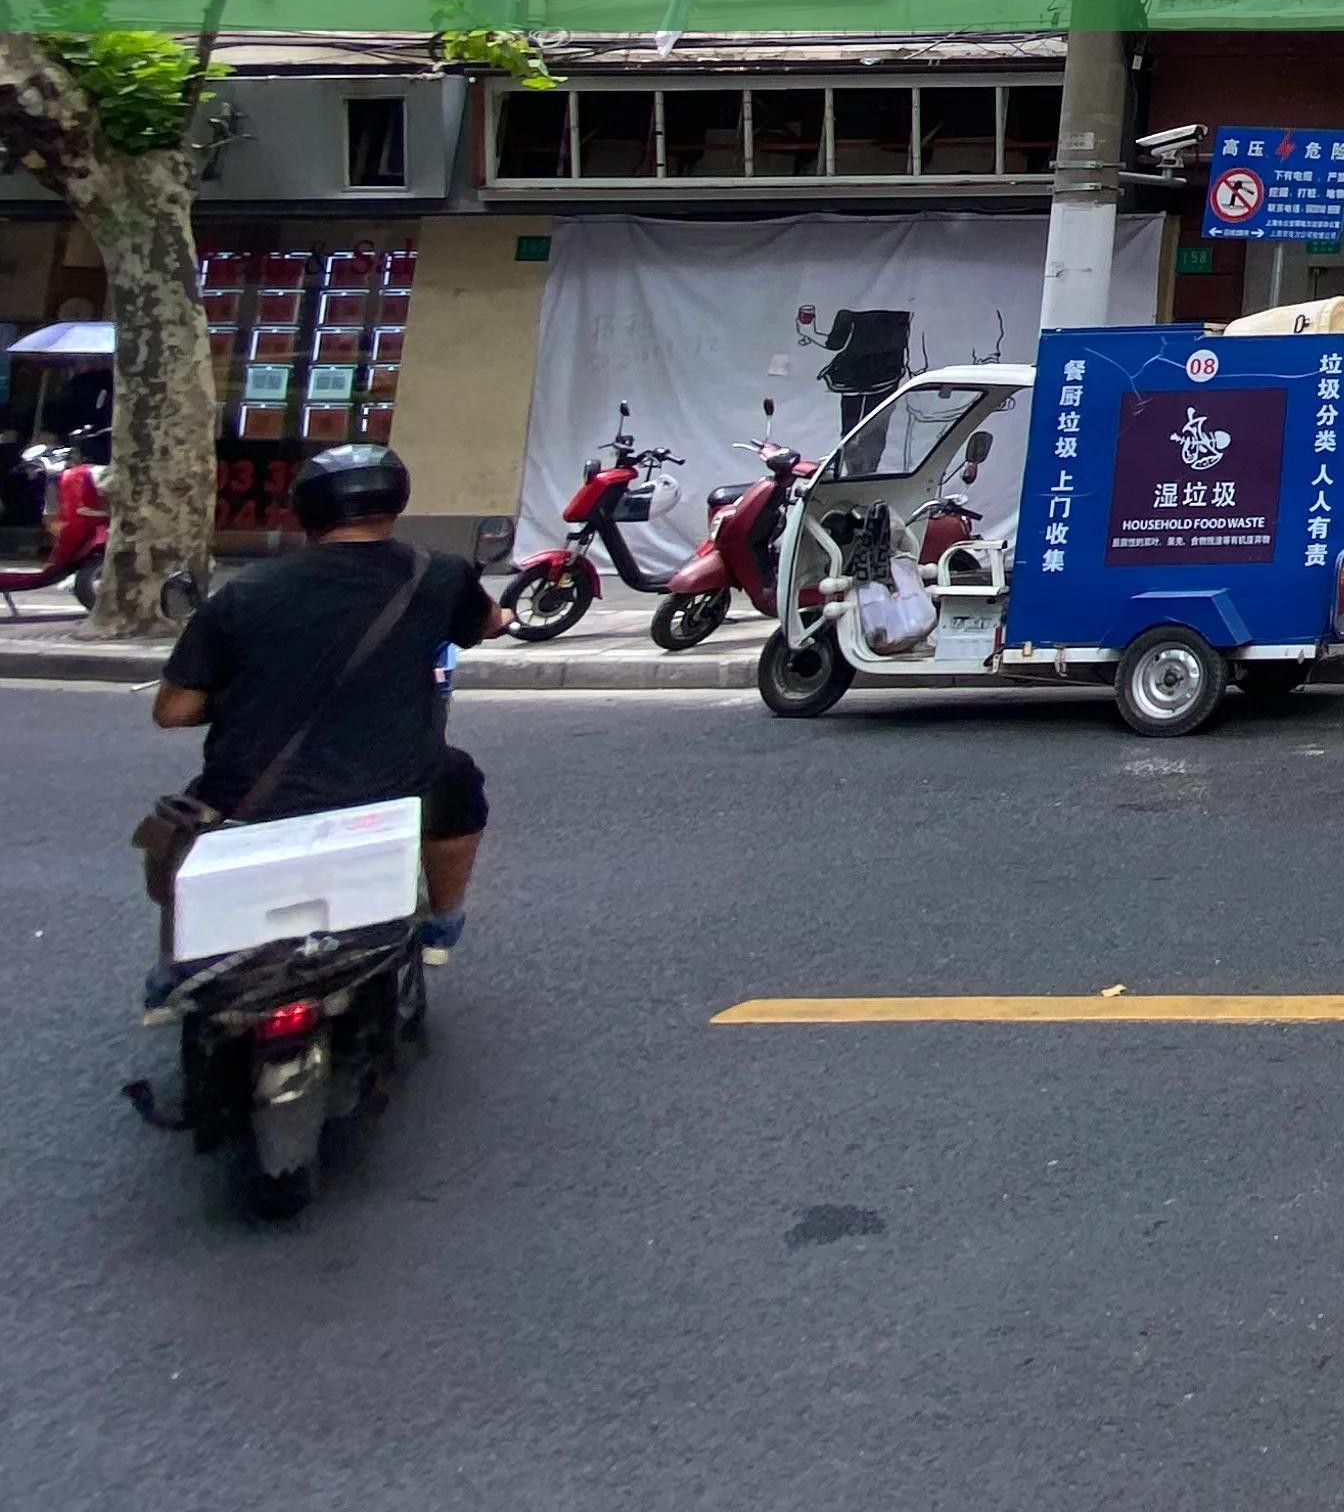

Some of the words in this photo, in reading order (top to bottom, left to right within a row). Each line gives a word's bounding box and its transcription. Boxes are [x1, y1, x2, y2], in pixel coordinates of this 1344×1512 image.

[1222, 138, 1265, 157] 高压
[1189, 358, 1216, 376] 08
[1054, 359, 1087, 458] 餐厨垃圾
[1313, 352, 1344, 453] 垃圾分类
[1042, 469, 1074, 573] 上门收集
[1122, 518, 1192, 531] HOUSEHOLD
[1193, 517, 1227, 530] FOOD
[1227, 516, 1265, 529] WASTE
[1153, 481, 1237, 509] 湿垃圾
[1304, 463, 1334, 567] 人人有责
